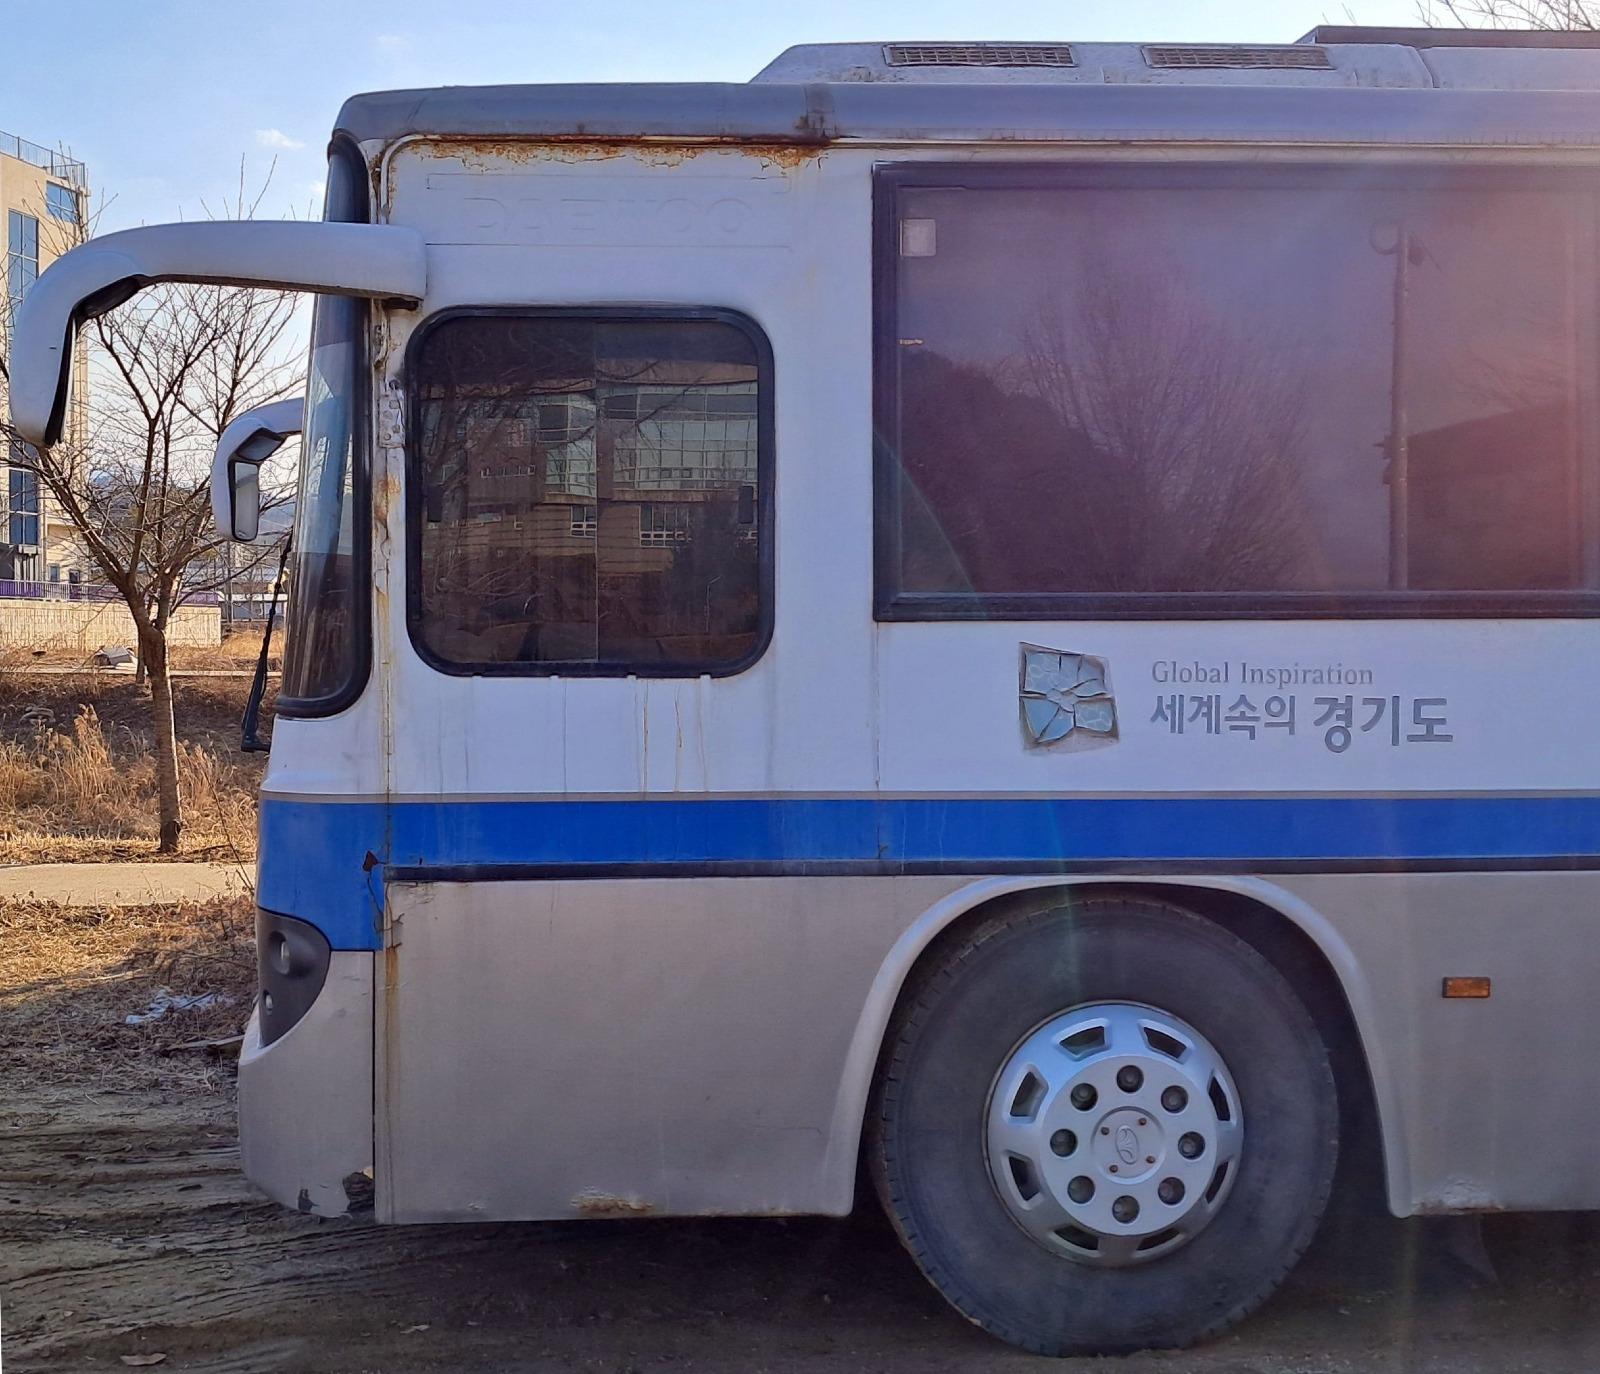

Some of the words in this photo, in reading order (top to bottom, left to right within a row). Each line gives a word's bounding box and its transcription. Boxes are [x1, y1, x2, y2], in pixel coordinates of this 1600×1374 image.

[1151, 660, 1229, 684] Global
[1240, 661, 1374, 690] Inspiration
[1149, 693, 1296, 741] 세계속의
[1312, 694, 1454, 754] 경기도
